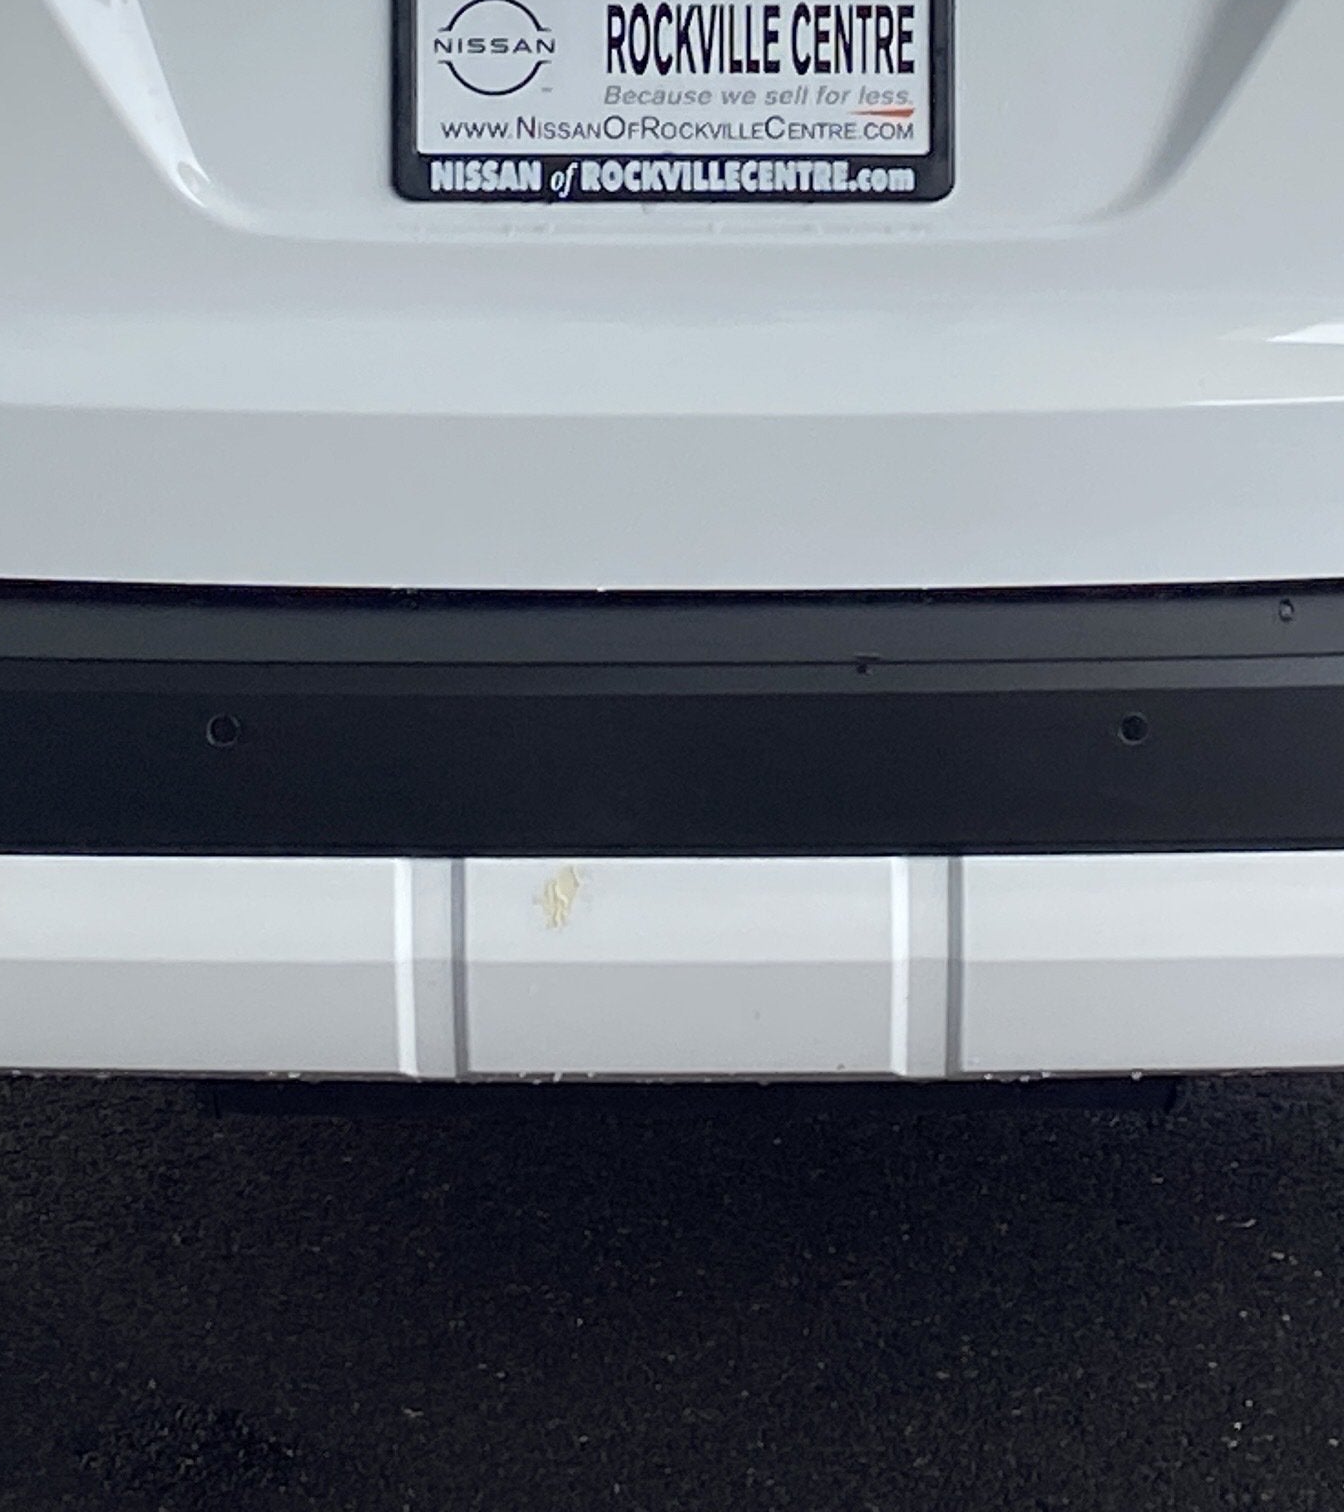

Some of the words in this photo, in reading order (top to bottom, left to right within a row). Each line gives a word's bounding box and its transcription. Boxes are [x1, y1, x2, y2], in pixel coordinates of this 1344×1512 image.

[434, 38, 555, 55] NISSAN
[607, 3, 780, 75] ROCKVILLE
[791, 3, 915, 75] CENTRE
[604, 86, 713, 105] Because
[720, 91, 756, 105] we
[765, 86, 807, 105] sell
[816, 86, 851, 105] for
[857, 86, 914, 105] less.
[431, 160, 542, 192] NISSAN
[550, 162, 578, 198] of
[581, 160, 915, 192] ROCKVILLECENTRE.com
